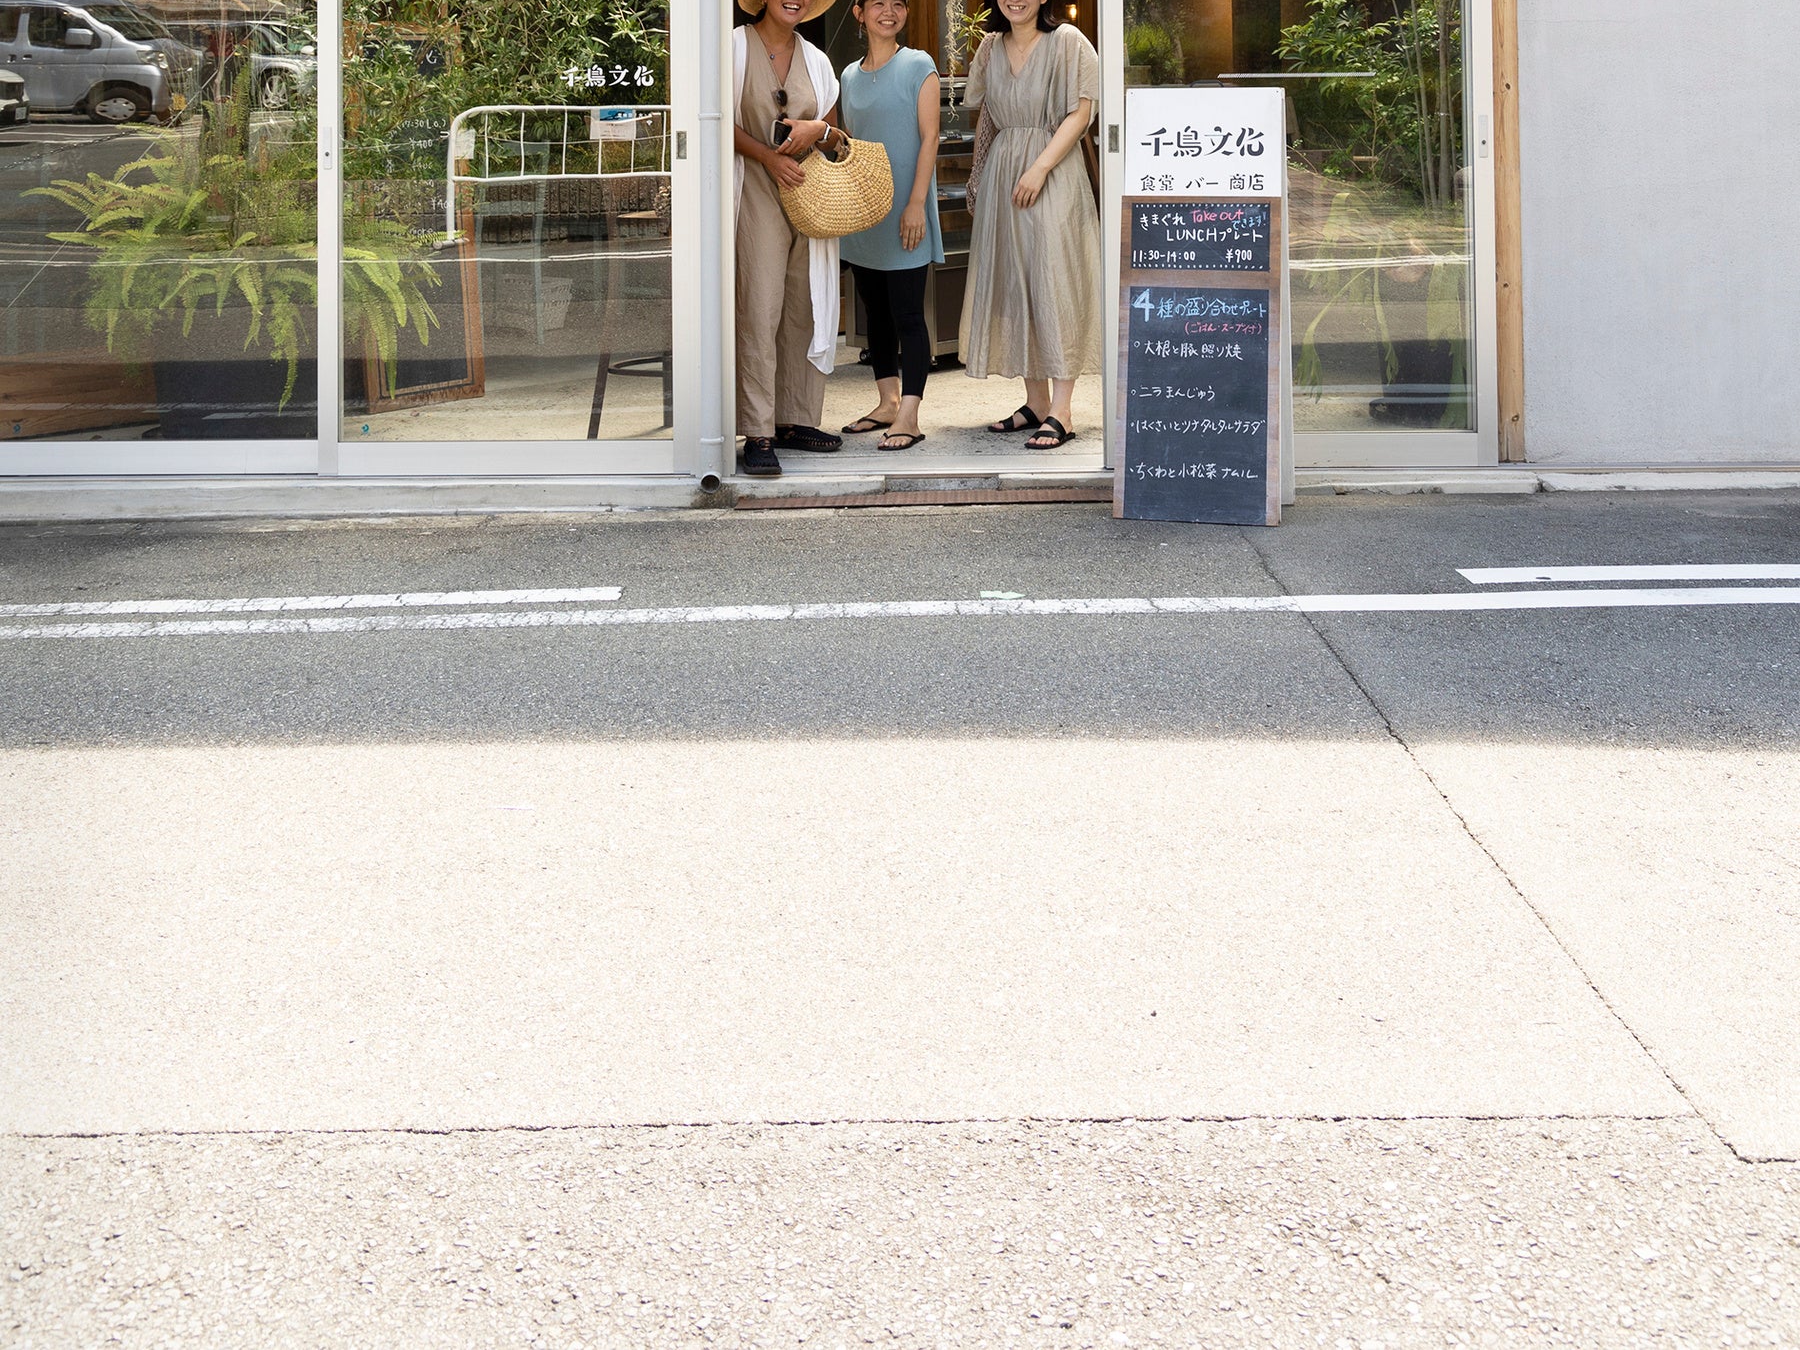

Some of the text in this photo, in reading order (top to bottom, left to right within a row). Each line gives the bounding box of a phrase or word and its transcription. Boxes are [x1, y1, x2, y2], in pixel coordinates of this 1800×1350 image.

[560, 64, 655, 87] 千鳥文化
[1141, 125, 1265, 157] 千鳥文化
[1140, 173, 1265, 192] 食堂 バー 商店
[1140, 213, 1186, 231] きまぐれ
[1191, 209, 1245, 223] Take out
[1166, 227, 1264, 243] LUNCHプレート
[1225, 248, 1253, 263] ¥900
